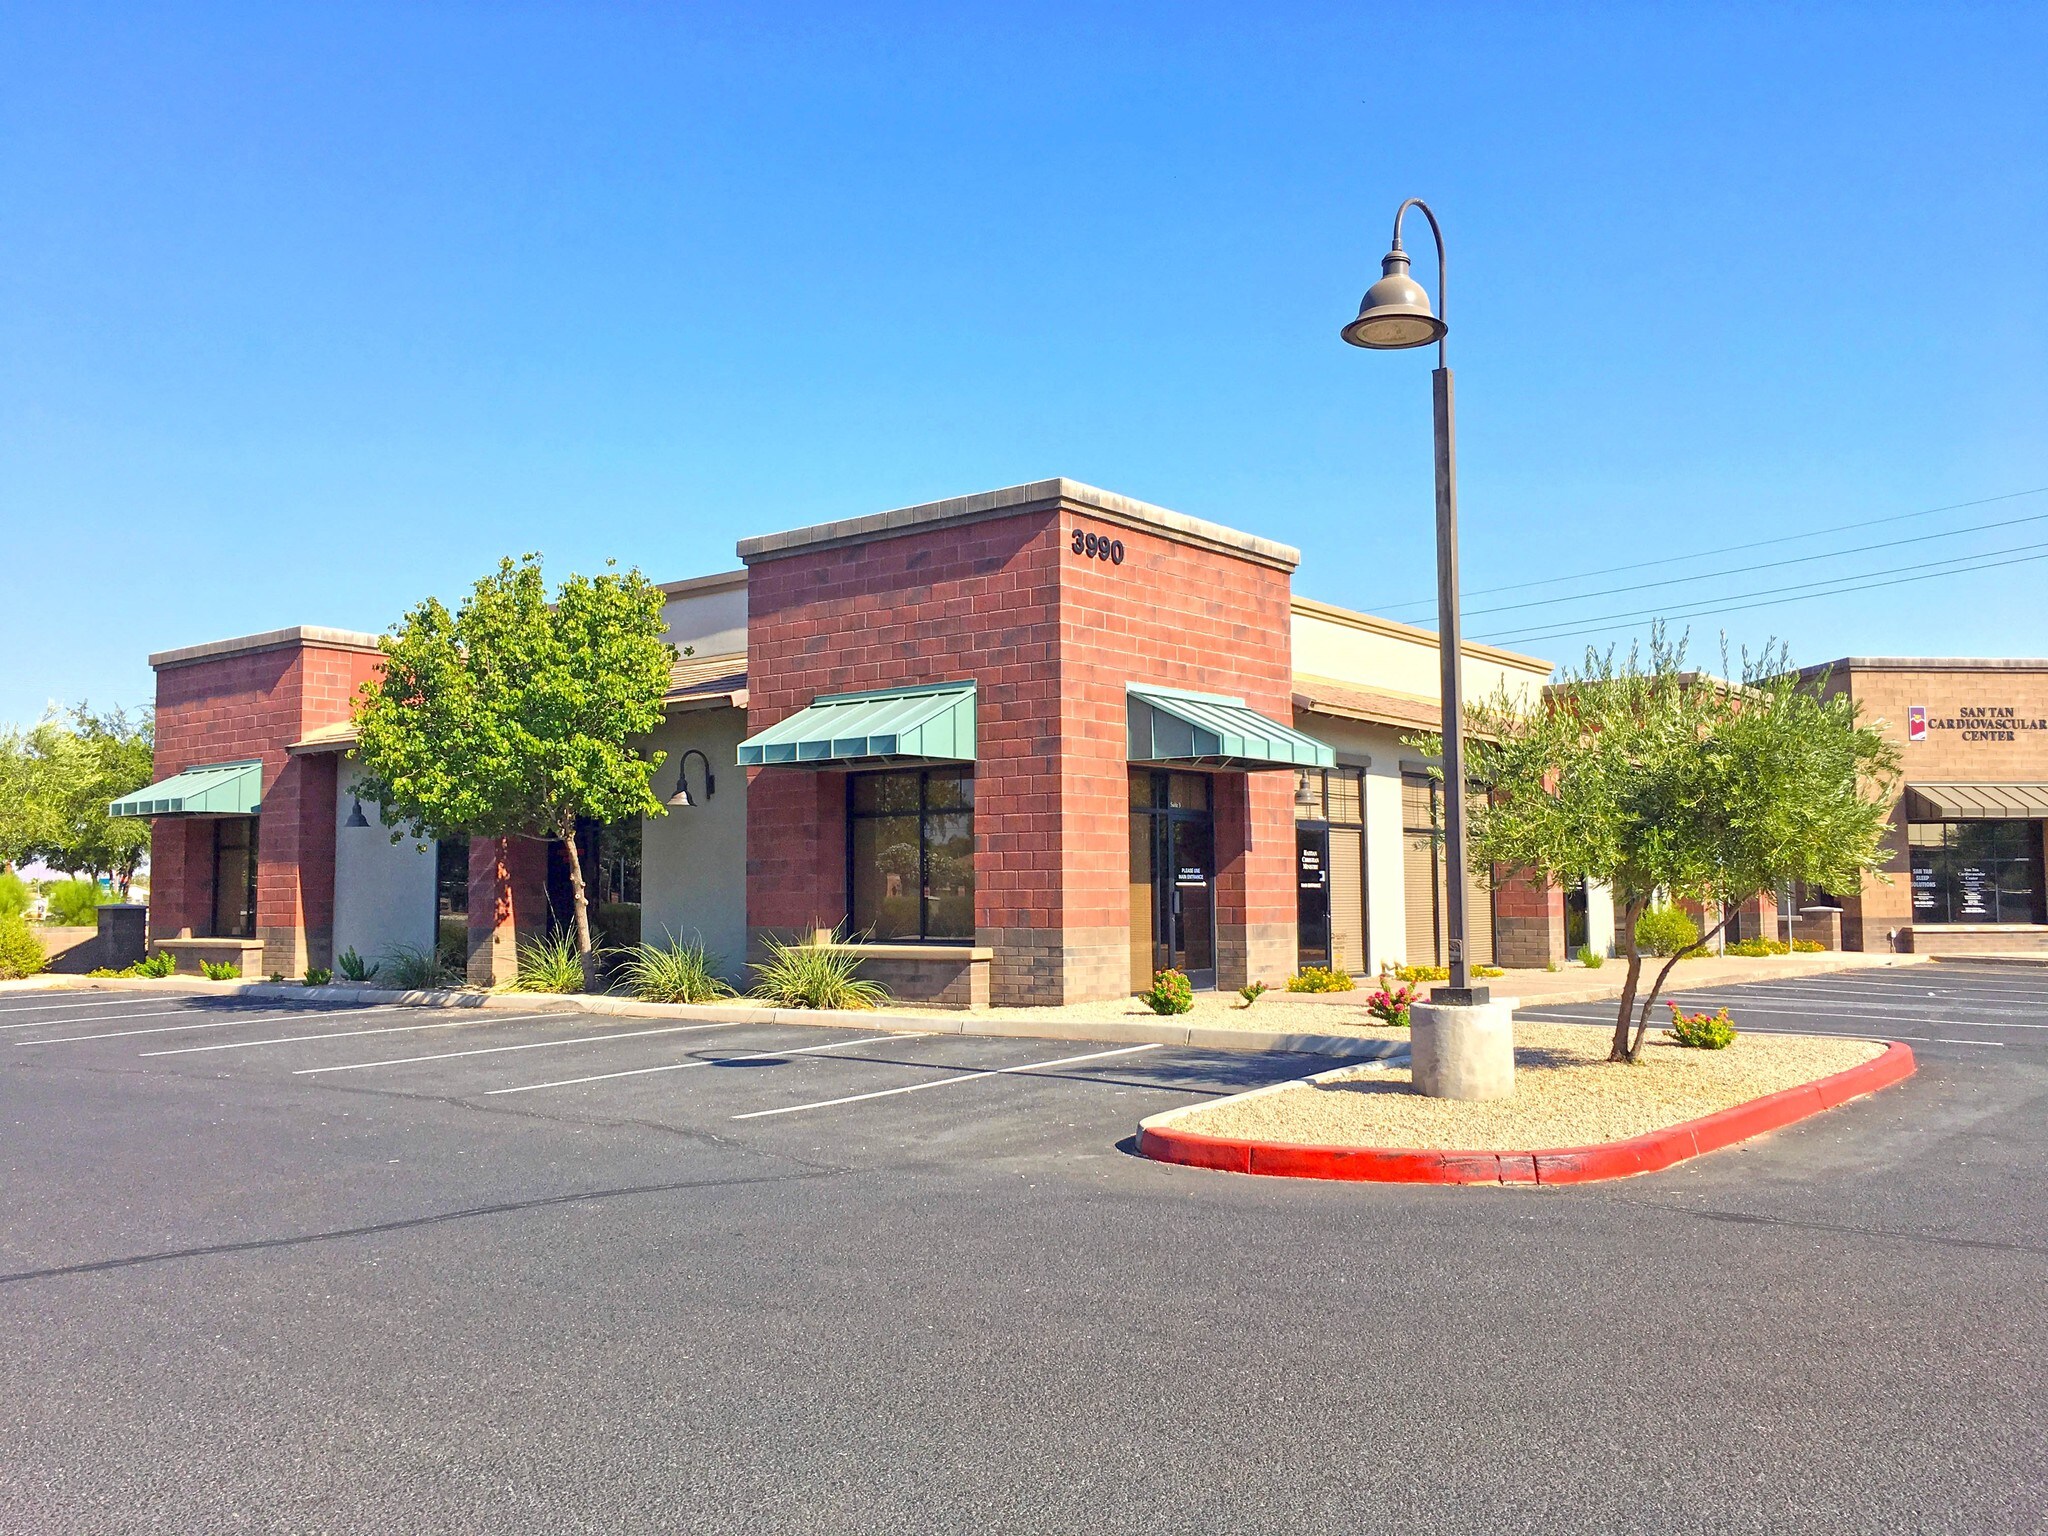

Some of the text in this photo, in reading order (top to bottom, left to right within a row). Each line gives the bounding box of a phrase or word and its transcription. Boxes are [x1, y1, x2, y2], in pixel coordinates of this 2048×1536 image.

[1071, 528, 1124, 565] 3990
[1960, 707, 2014, 718] SAN TAN
[1928, 719, 2047, 730] CARDIOVASCULAR
[1962, 730, 2015, 741] CENTER
